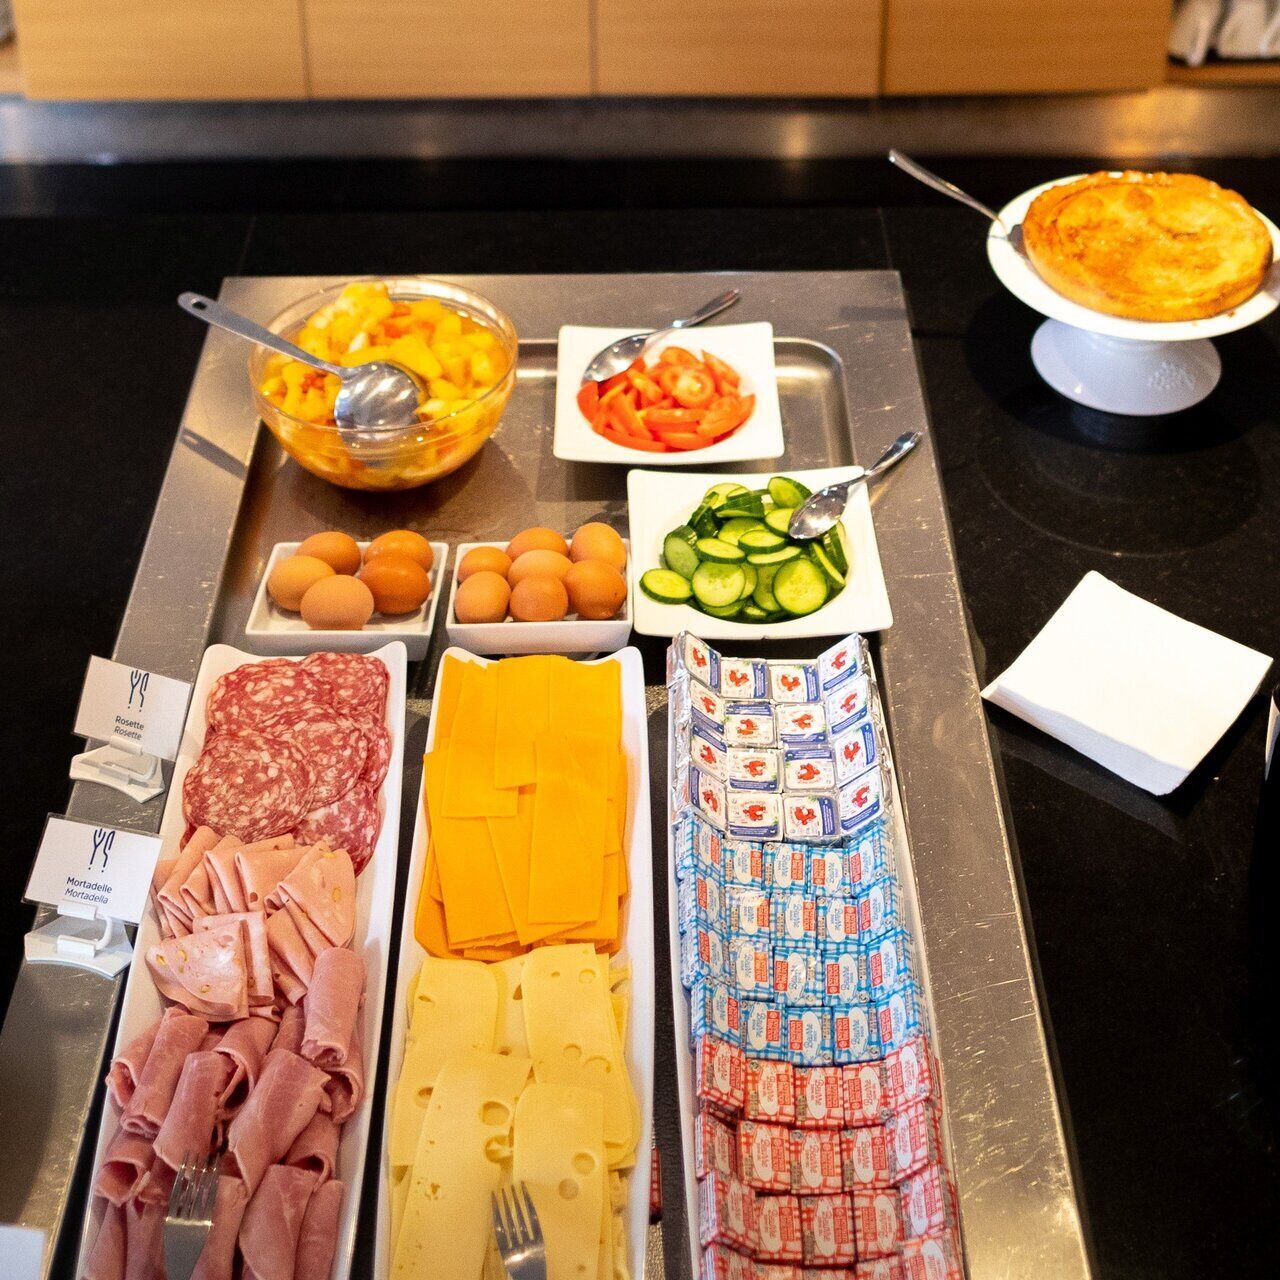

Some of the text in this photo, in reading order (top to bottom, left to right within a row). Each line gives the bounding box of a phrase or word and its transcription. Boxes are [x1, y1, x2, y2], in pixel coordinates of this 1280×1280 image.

[115, 715, 145, 731] Rosette
[114, 725, 142, 741] Rosette
[66, 876, 113, 893] Mortadelle
[64, 888, 109, 904] Mortadella
